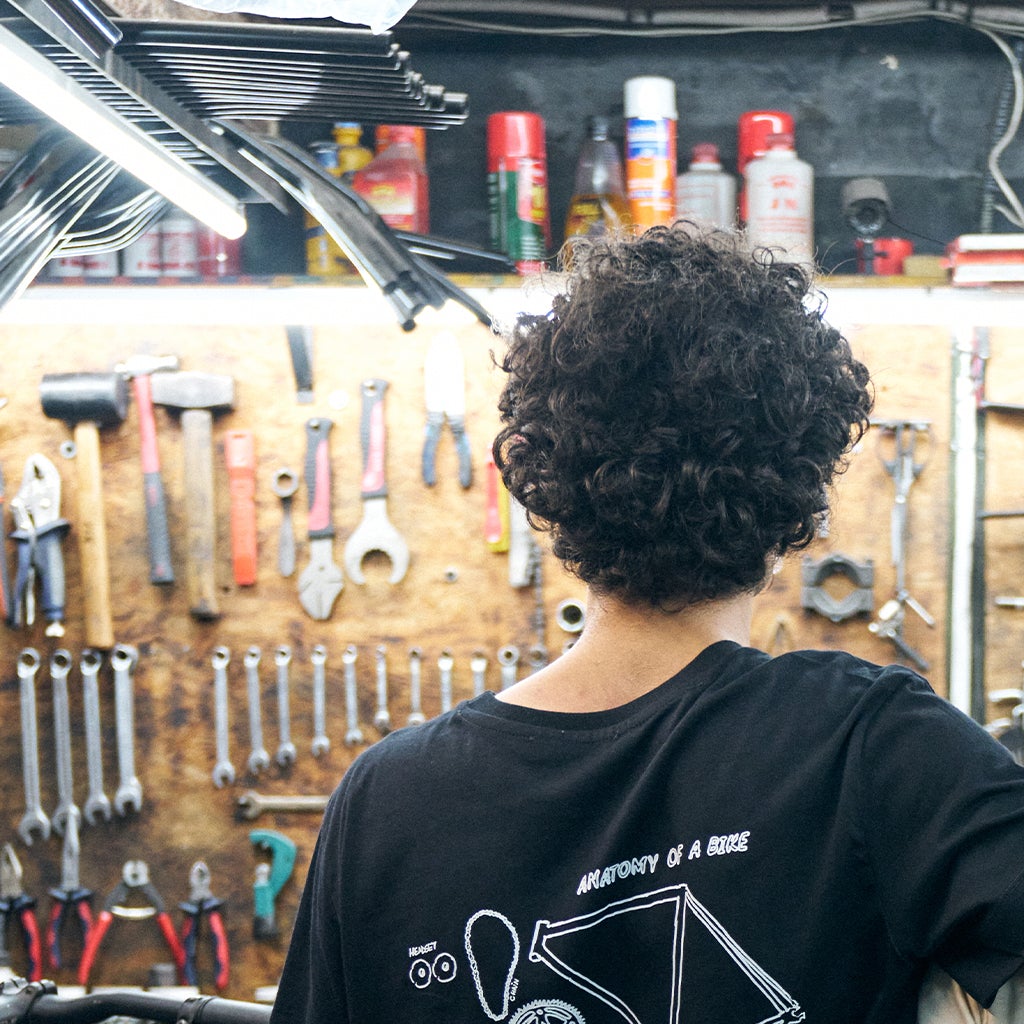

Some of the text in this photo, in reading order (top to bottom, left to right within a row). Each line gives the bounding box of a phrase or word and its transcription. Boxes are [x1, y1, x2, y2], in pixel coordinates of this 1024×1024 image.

[576, 831, 751, 896] ANATOMY OF A BIKE
